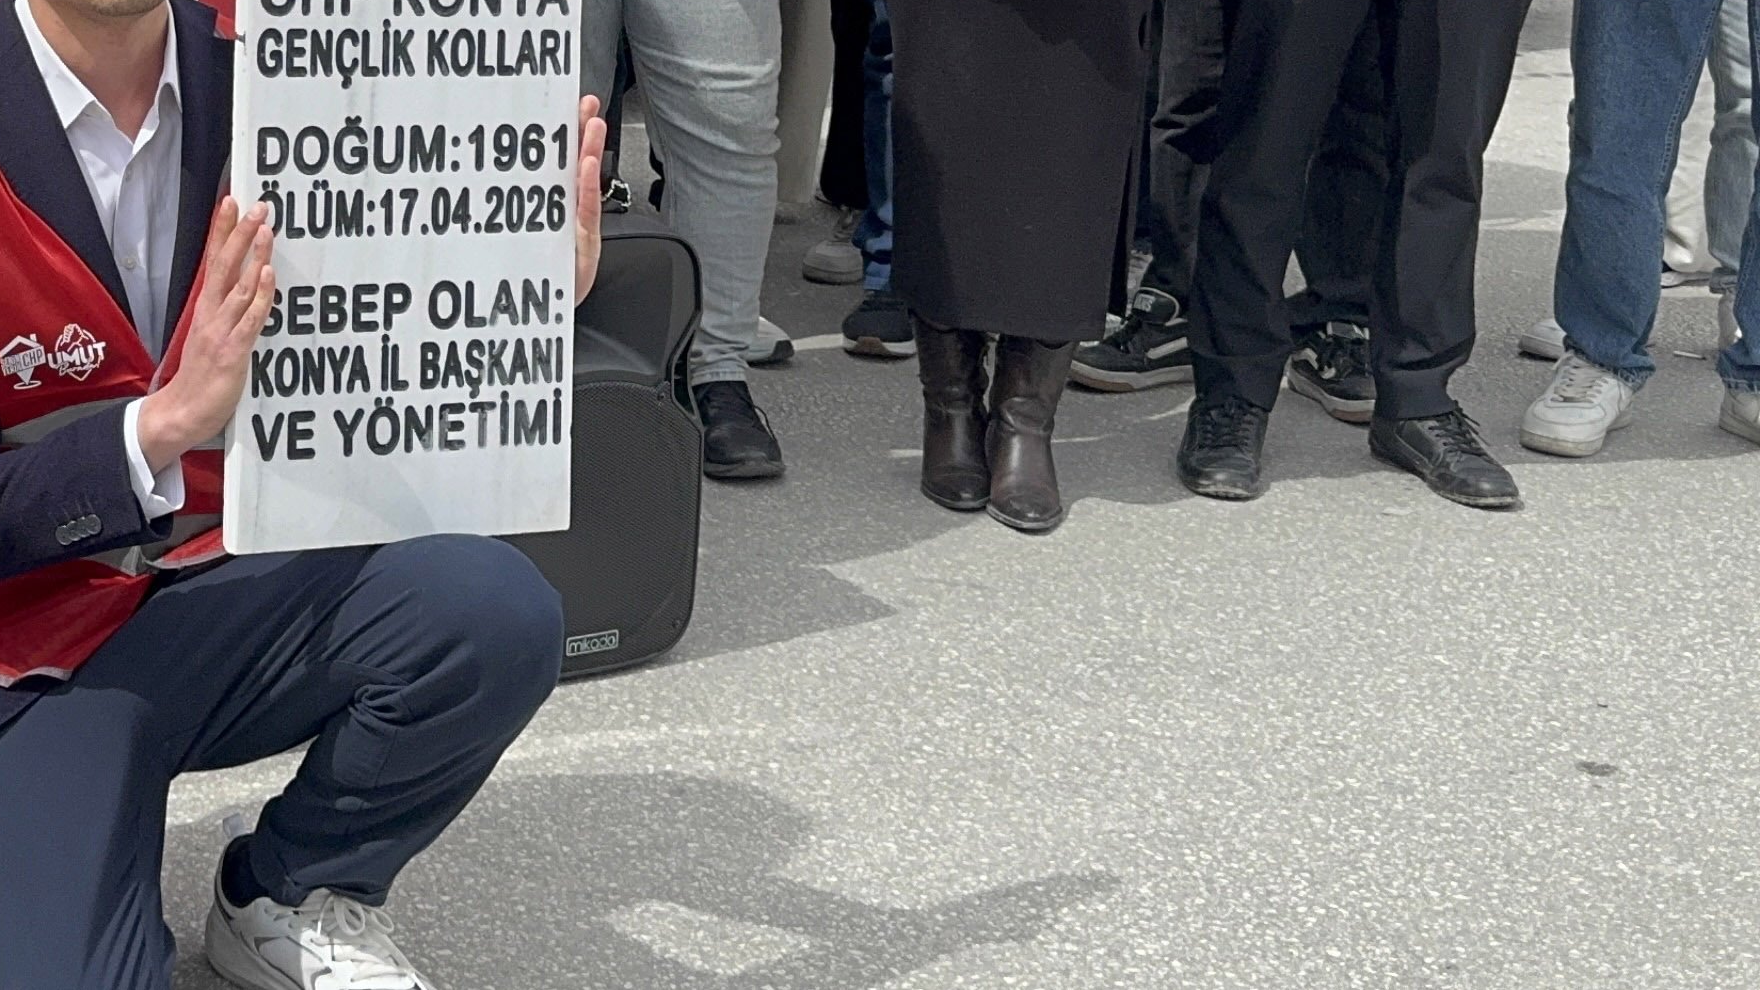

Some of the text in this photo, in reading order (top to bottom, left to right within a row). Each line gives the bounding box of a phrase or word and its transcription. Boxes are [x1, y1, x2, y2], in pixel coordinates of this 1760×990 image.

[256, 18, 572, 90] GENÇLİK KOLLARI
[256, 114, 569, 176] DOĞUM:1961
[257, 178, 567, 240] ÖLÜM:17.04.2026
[258, 277, 565, 338] SEBEP OLAN:
[21, 348, 44, 368] CHP
[46, 340, 107, 370] UMUT
[250, 333, 565, 400] KONYA İL BAŞKANI
[251, 387, 563, 462] VE YÖNETİMİ
